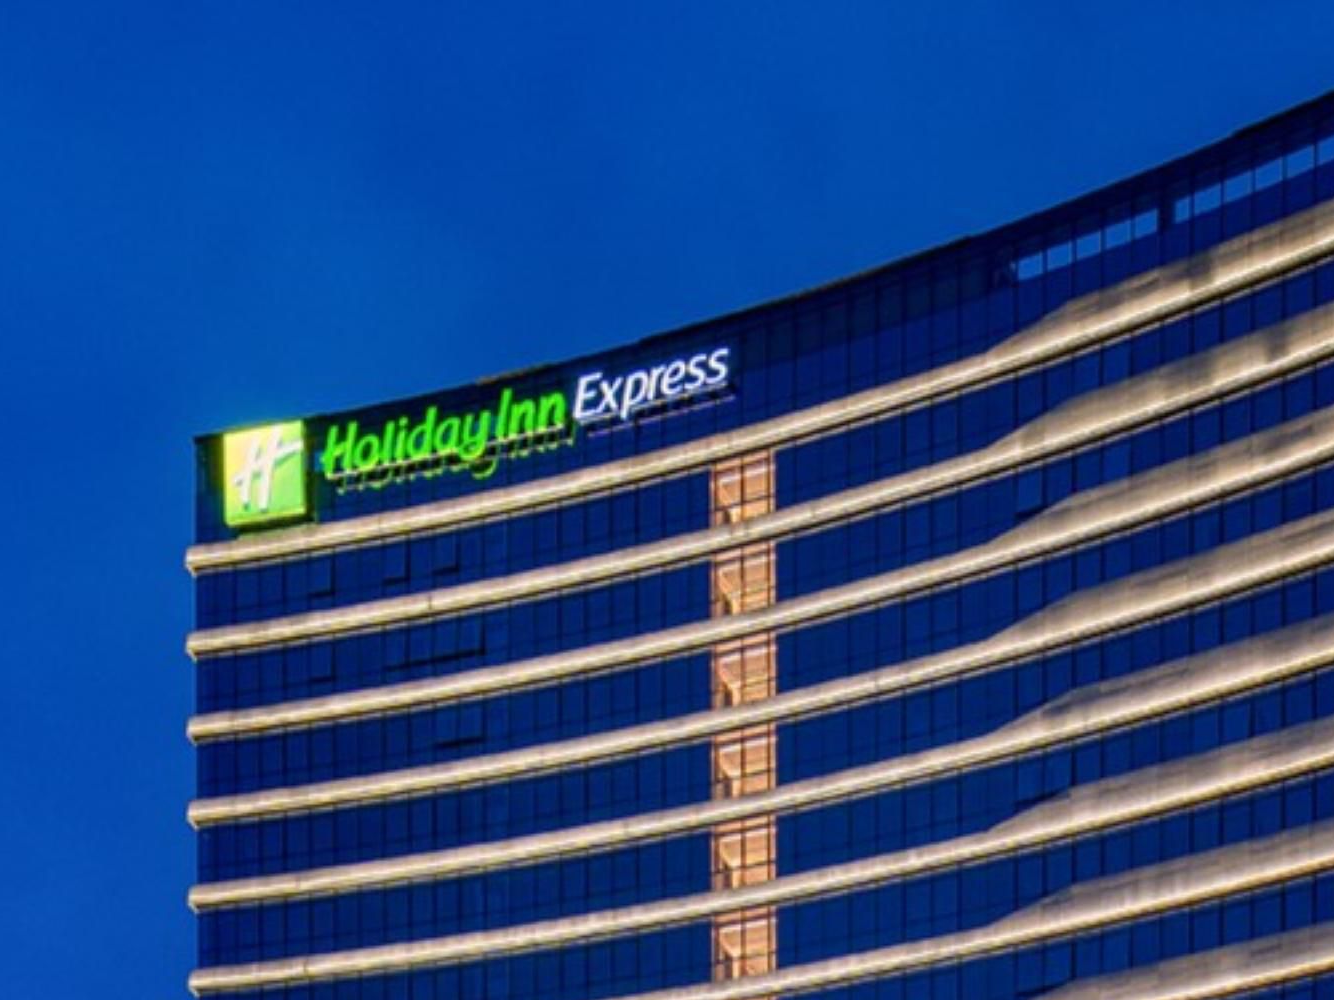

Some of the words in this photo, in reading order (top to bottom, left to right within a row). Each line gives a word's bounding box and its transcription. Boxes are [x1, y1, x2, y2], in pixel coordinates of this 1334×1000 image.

[320, 406, 491, 479] Holiday
[495, 387, 566, 442] Inn
[572, 348, 729, 420] Express
